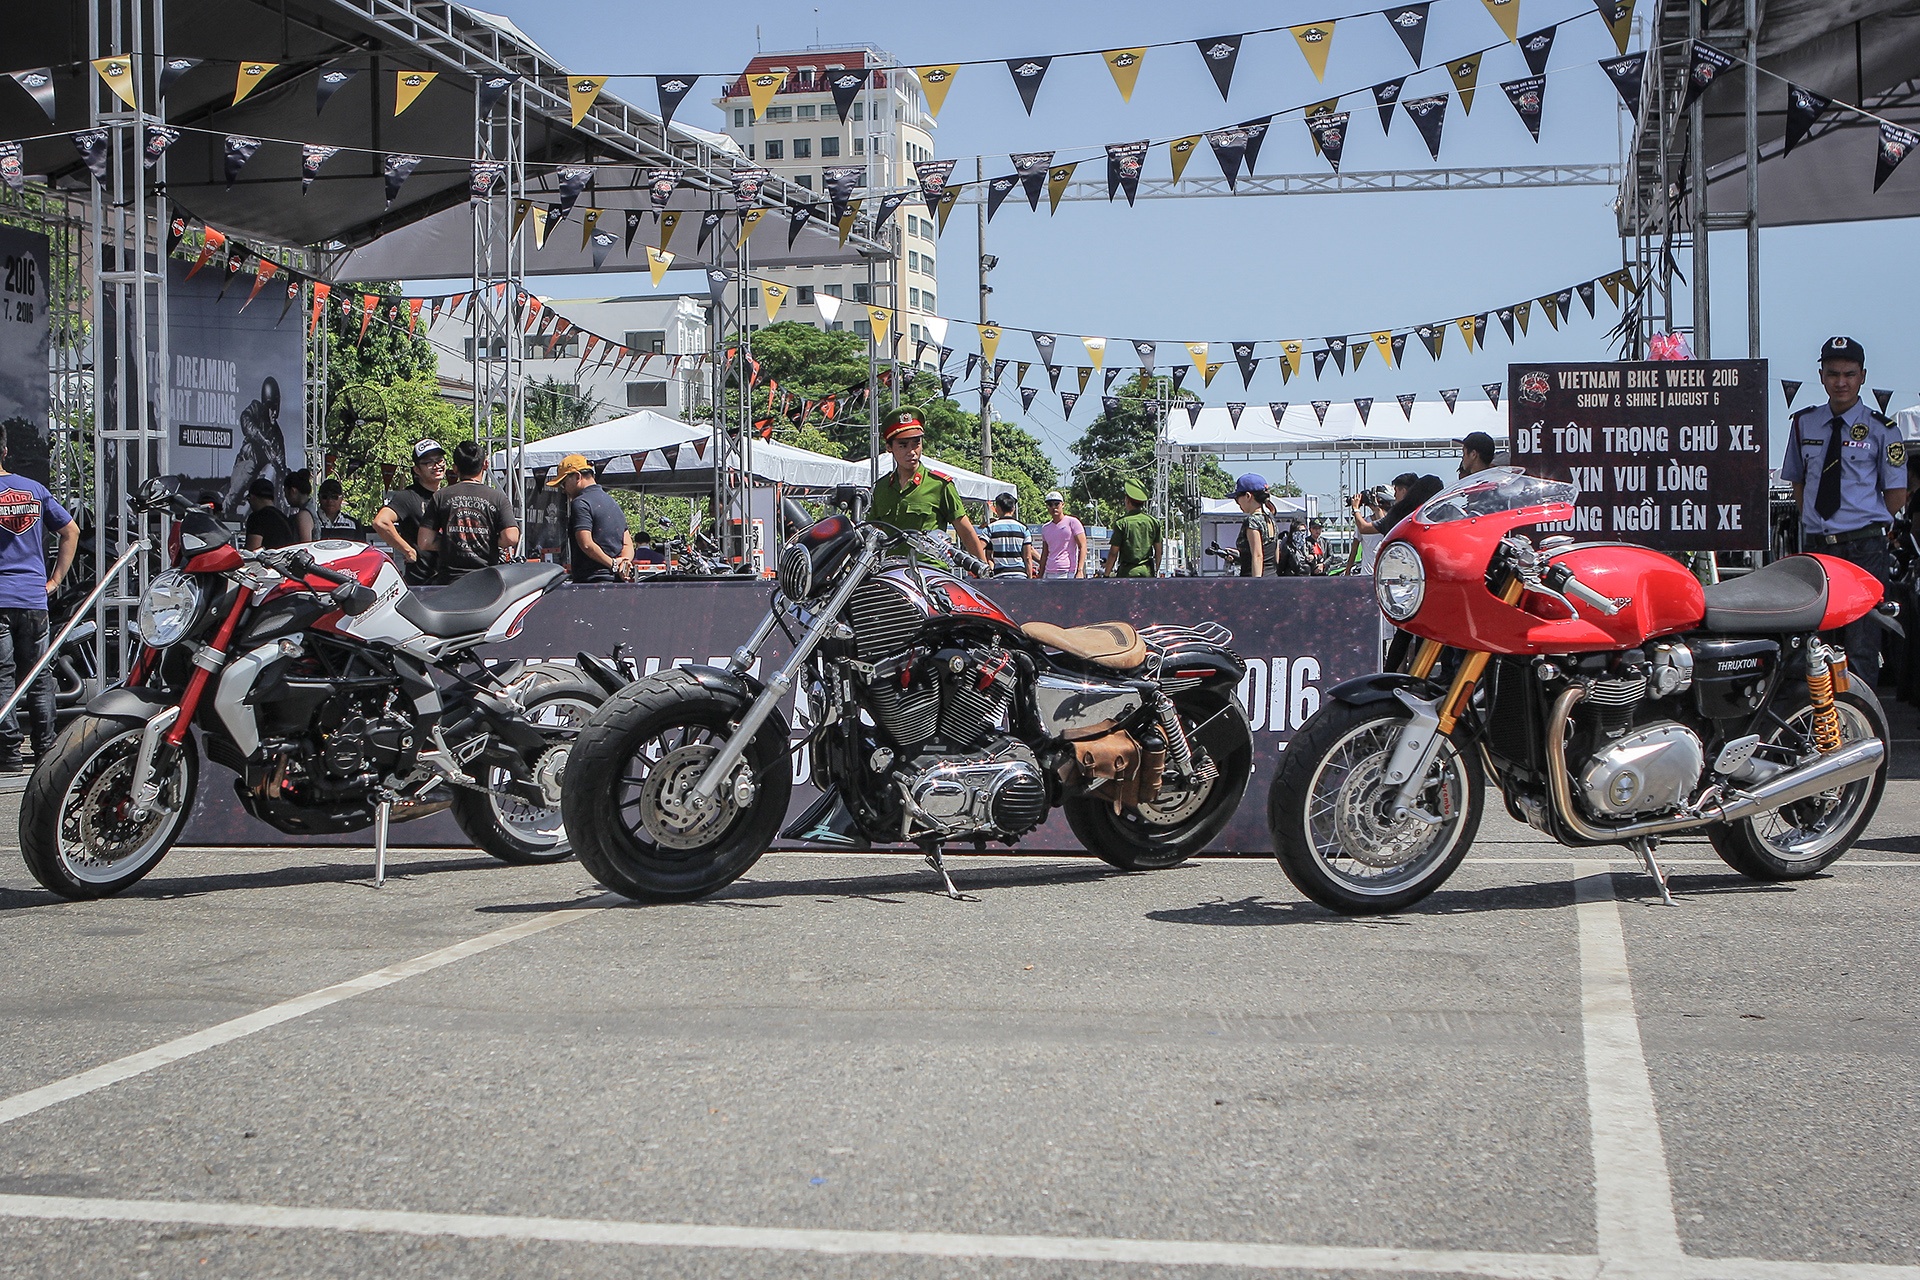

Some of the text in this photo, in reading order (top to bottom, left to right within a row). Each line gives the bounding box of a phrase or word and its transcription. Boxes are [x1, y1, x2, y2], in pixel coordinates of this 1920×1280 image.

[5, 255, 35, 296] 2016
[16, 301, 34, 323] 2016
[176, 354, 239, 393] DREAMING.
[1558, 369, 1739, 389] VIETNAM BIKE WEEK 2016
[197, 391, 239, 425] RIDING.
[1577, 394, 1609, 408] SHOW
[1614, 394, 1621, 407] &
[1626, 394, 1657, 407] SHINE
[1667, 392, 1708, 406] AUGUST
[1713, 392, 1720, 405] 6
[1517, 420, 1761, 456] ĐỂ TÔN TRỌNG CHỦ XE,
[1570, 459, 1708, 492] XIN VUI LÒNG
[452, 501, 485, 511] SAIGON
[1612, 497, 1660, 531] NGỒI
[1671, 499, 1706, 531] LÊN
[1717, 504, 1742, 531] XE
[1718, 658, 1758, 671] THRUXTON
[1442, 783, 1451, 815] brembo
